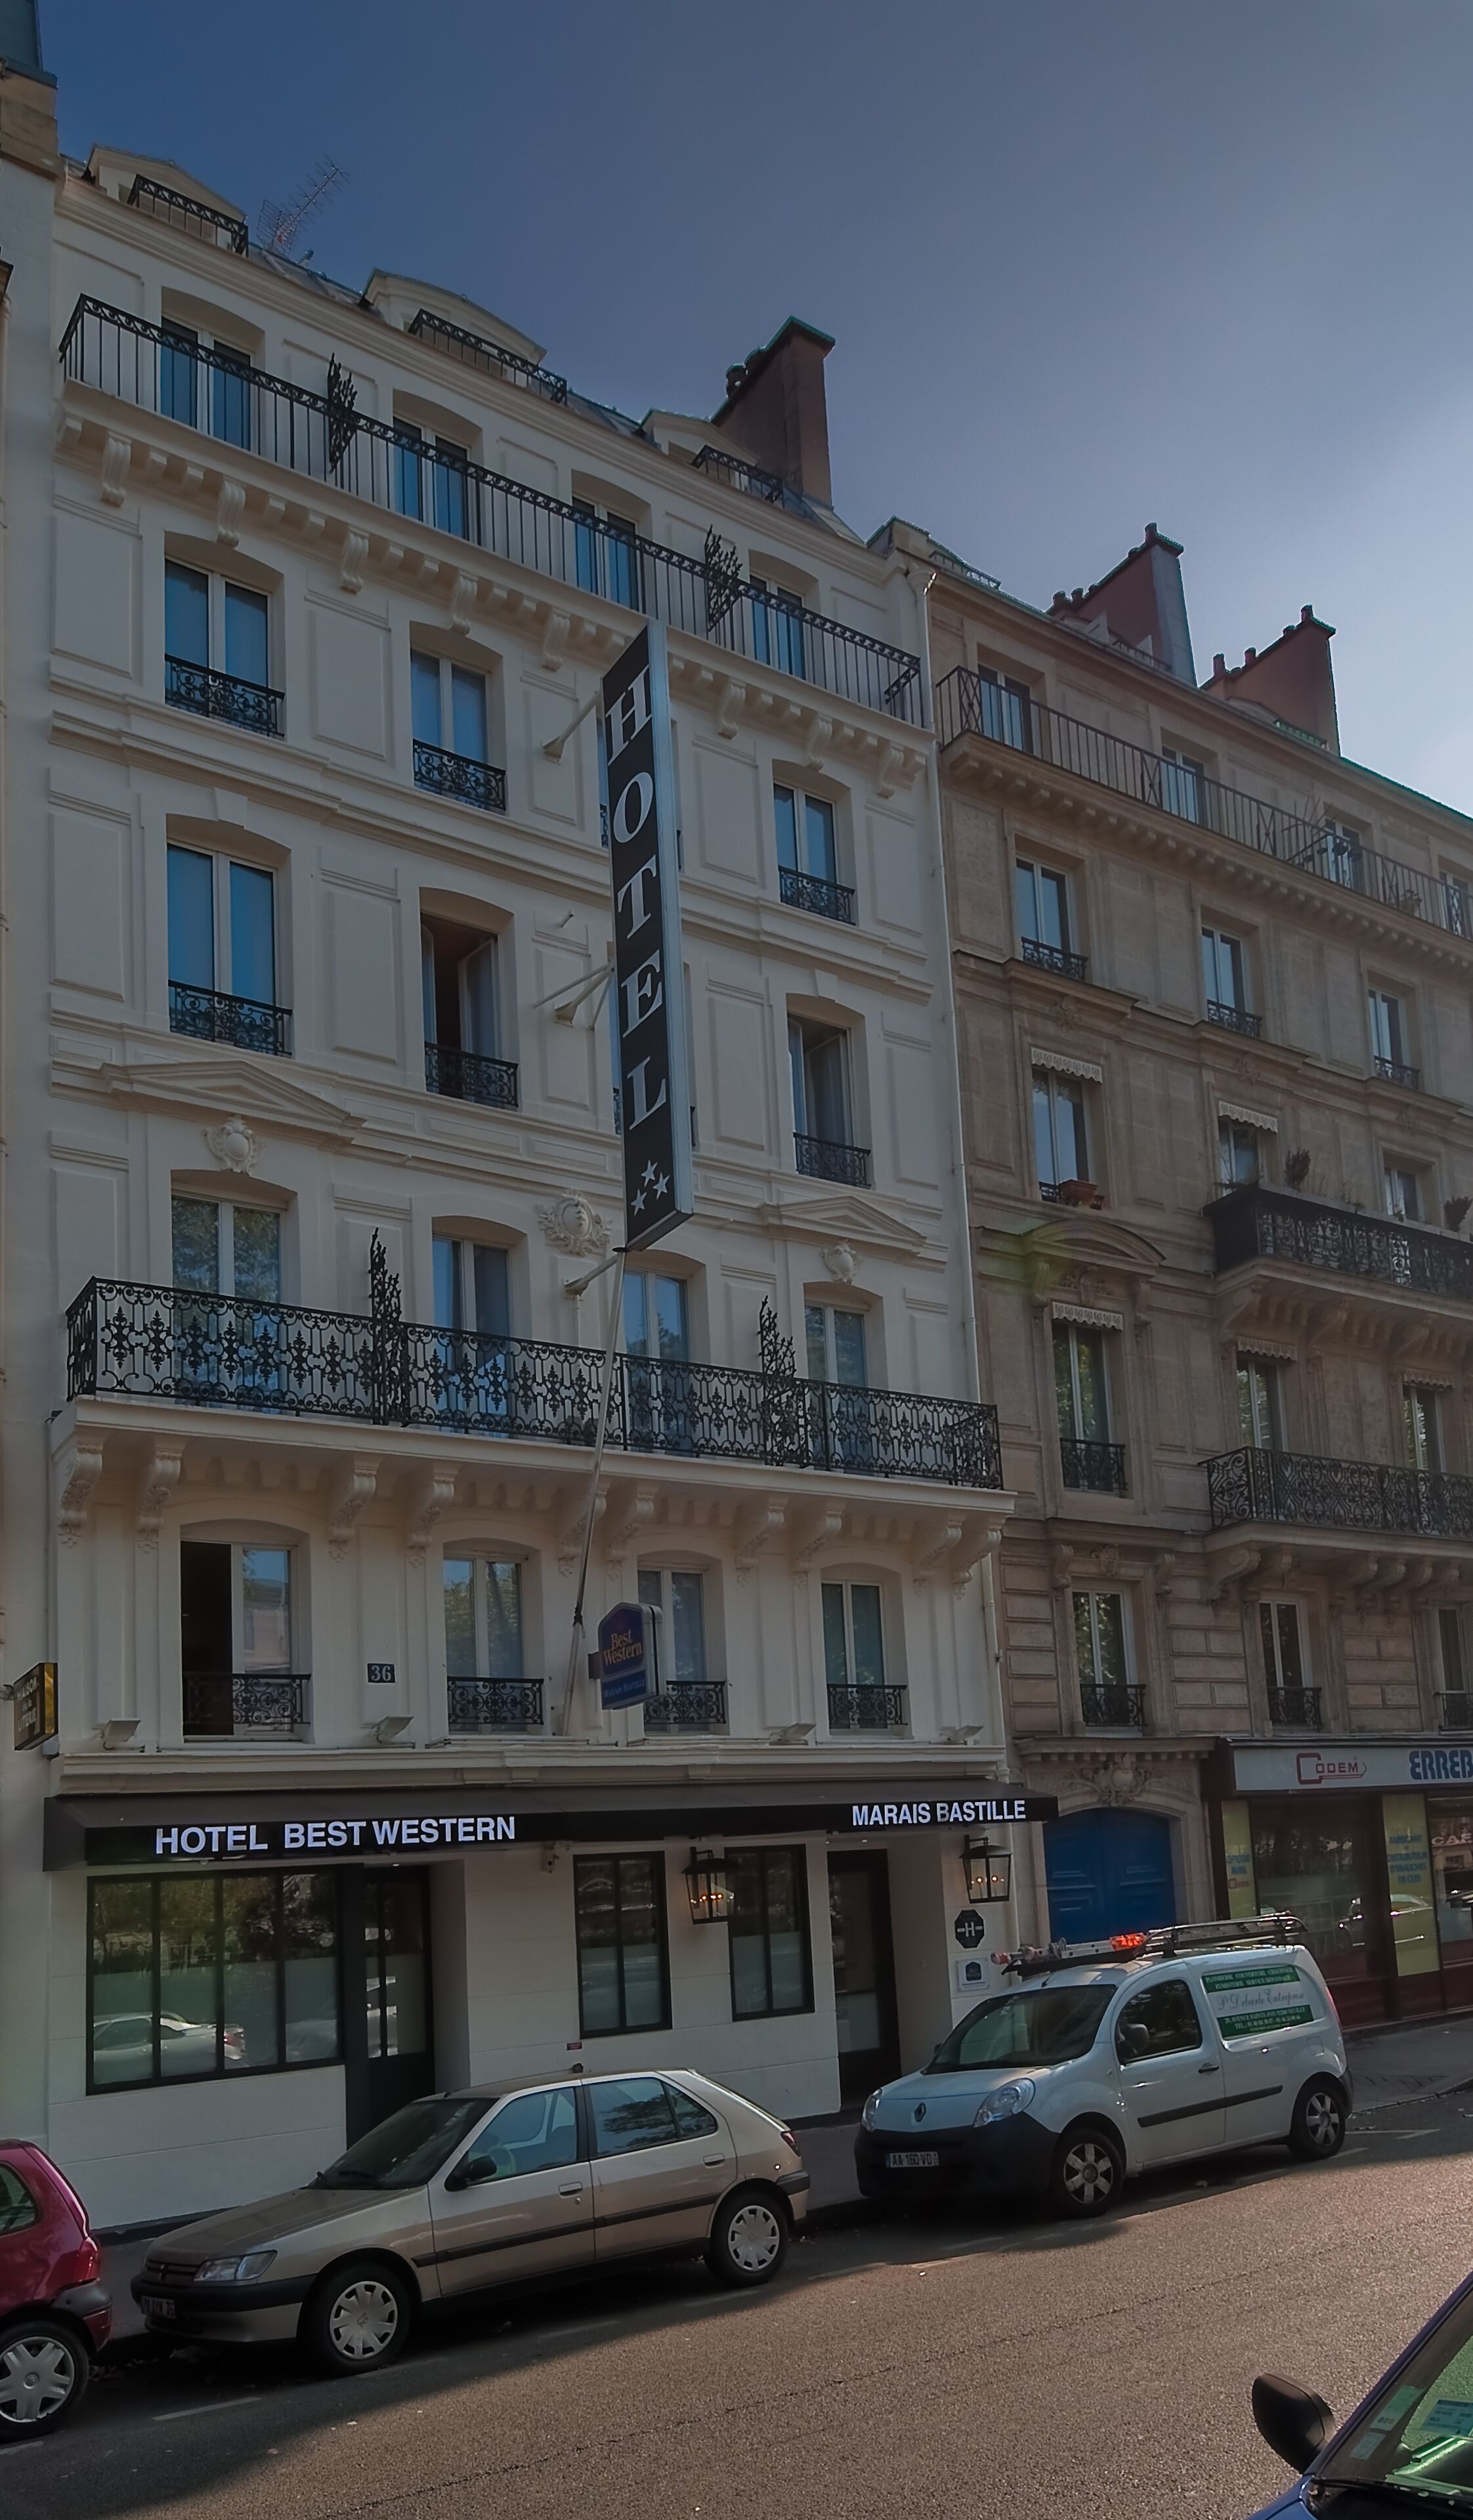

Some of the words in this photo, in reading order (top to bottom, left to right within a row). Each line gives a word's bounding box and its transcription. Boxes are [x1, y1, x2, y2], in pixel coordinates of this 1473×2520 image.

[605, 664, 667, 1131] HOTEL
[610, 1628, 632, 1650] Best
[603, 1641, 642, 1666] Western
[372, 1665, 391, 1681] 36
[1296, 1753, 1359, 1784] CODEM
[852, 1803, 931, 1826] MARAIS
[936, 1799, 1027, 1823] BASTILLE
[156, 1824, 268, 1855] HOTEL
[284, 1821, 367, 1848] BEST
[373, 1816, 516, 1845] WESTERN
